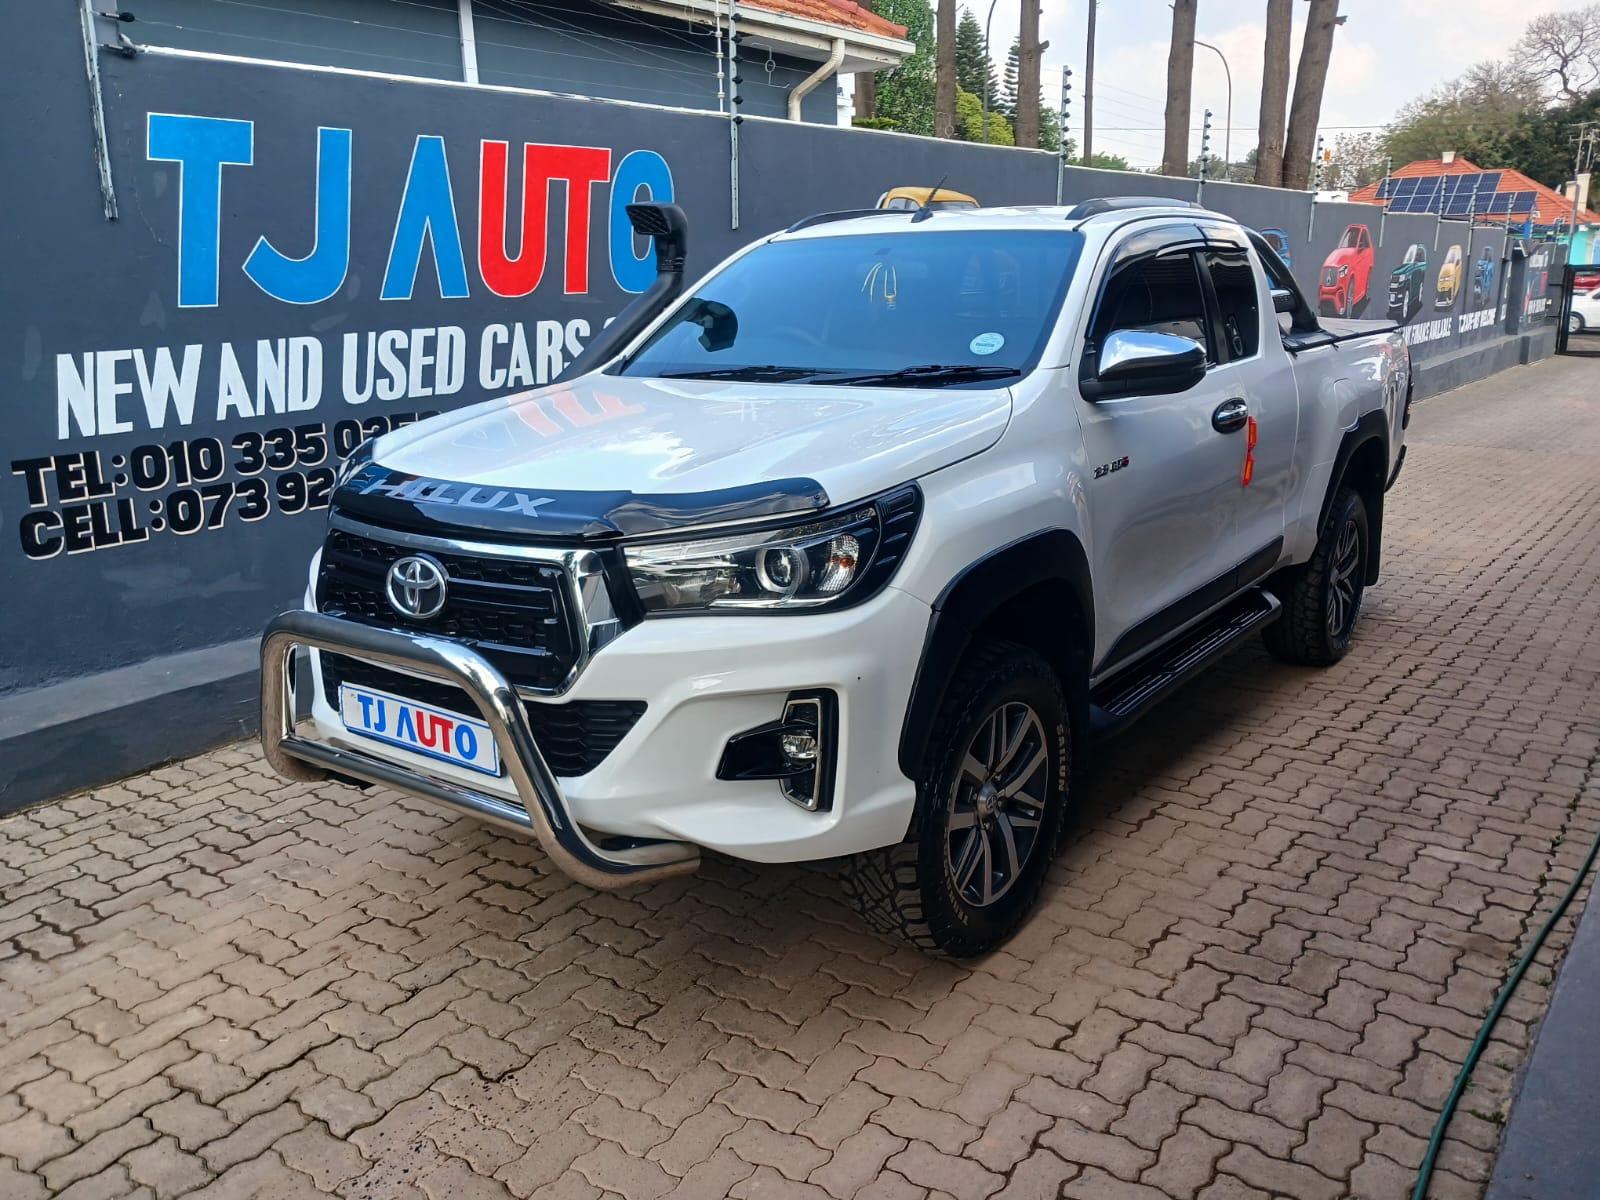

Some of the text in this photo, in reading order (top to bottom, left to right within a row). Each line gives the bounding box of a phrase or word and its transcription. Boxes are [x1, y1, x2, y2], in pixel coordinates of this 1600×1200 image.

[146, 112, 675, 308] TJ AUTO
[56, 318, 591, 440] NEW AND USED CARS
[231, 422, 328, 476] 335
[276, 465, 340, 516] 92
[358, 479, 556, 518] HILUX
[357, 693, 478, 760] TJ AUTO
[1056, 723, 1067, 792] SAILUN
